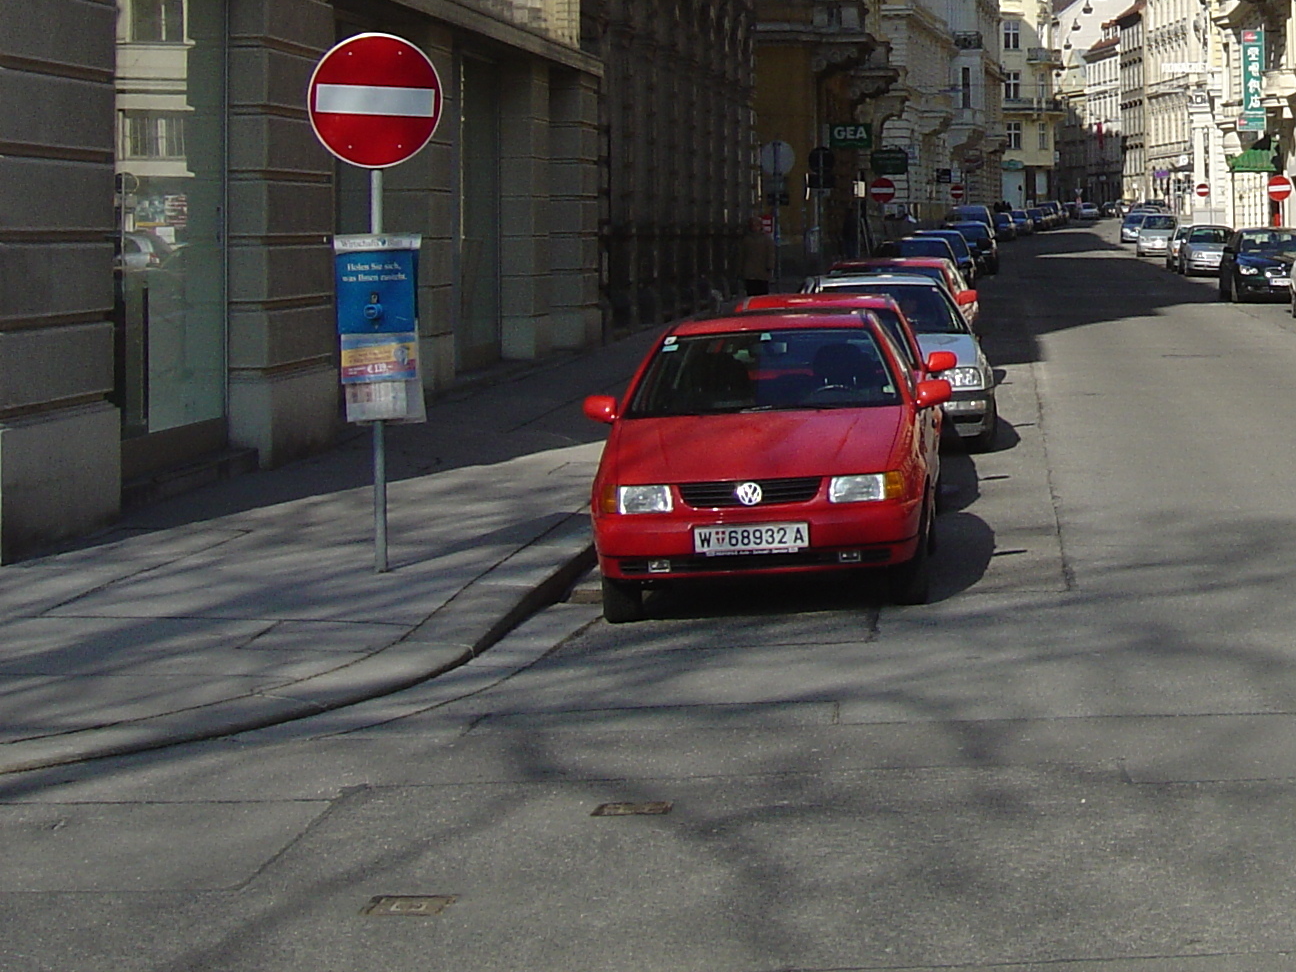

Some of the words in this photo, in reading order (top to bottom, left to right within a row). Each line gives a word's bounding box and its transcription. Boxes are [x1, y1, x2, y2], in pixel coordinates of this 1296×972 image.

[833, 126, 868, 140] GEA
[699, 531, 712, 548] W
[728, 527, 788, 547] 68932
[793, 527, 804, 544] A
